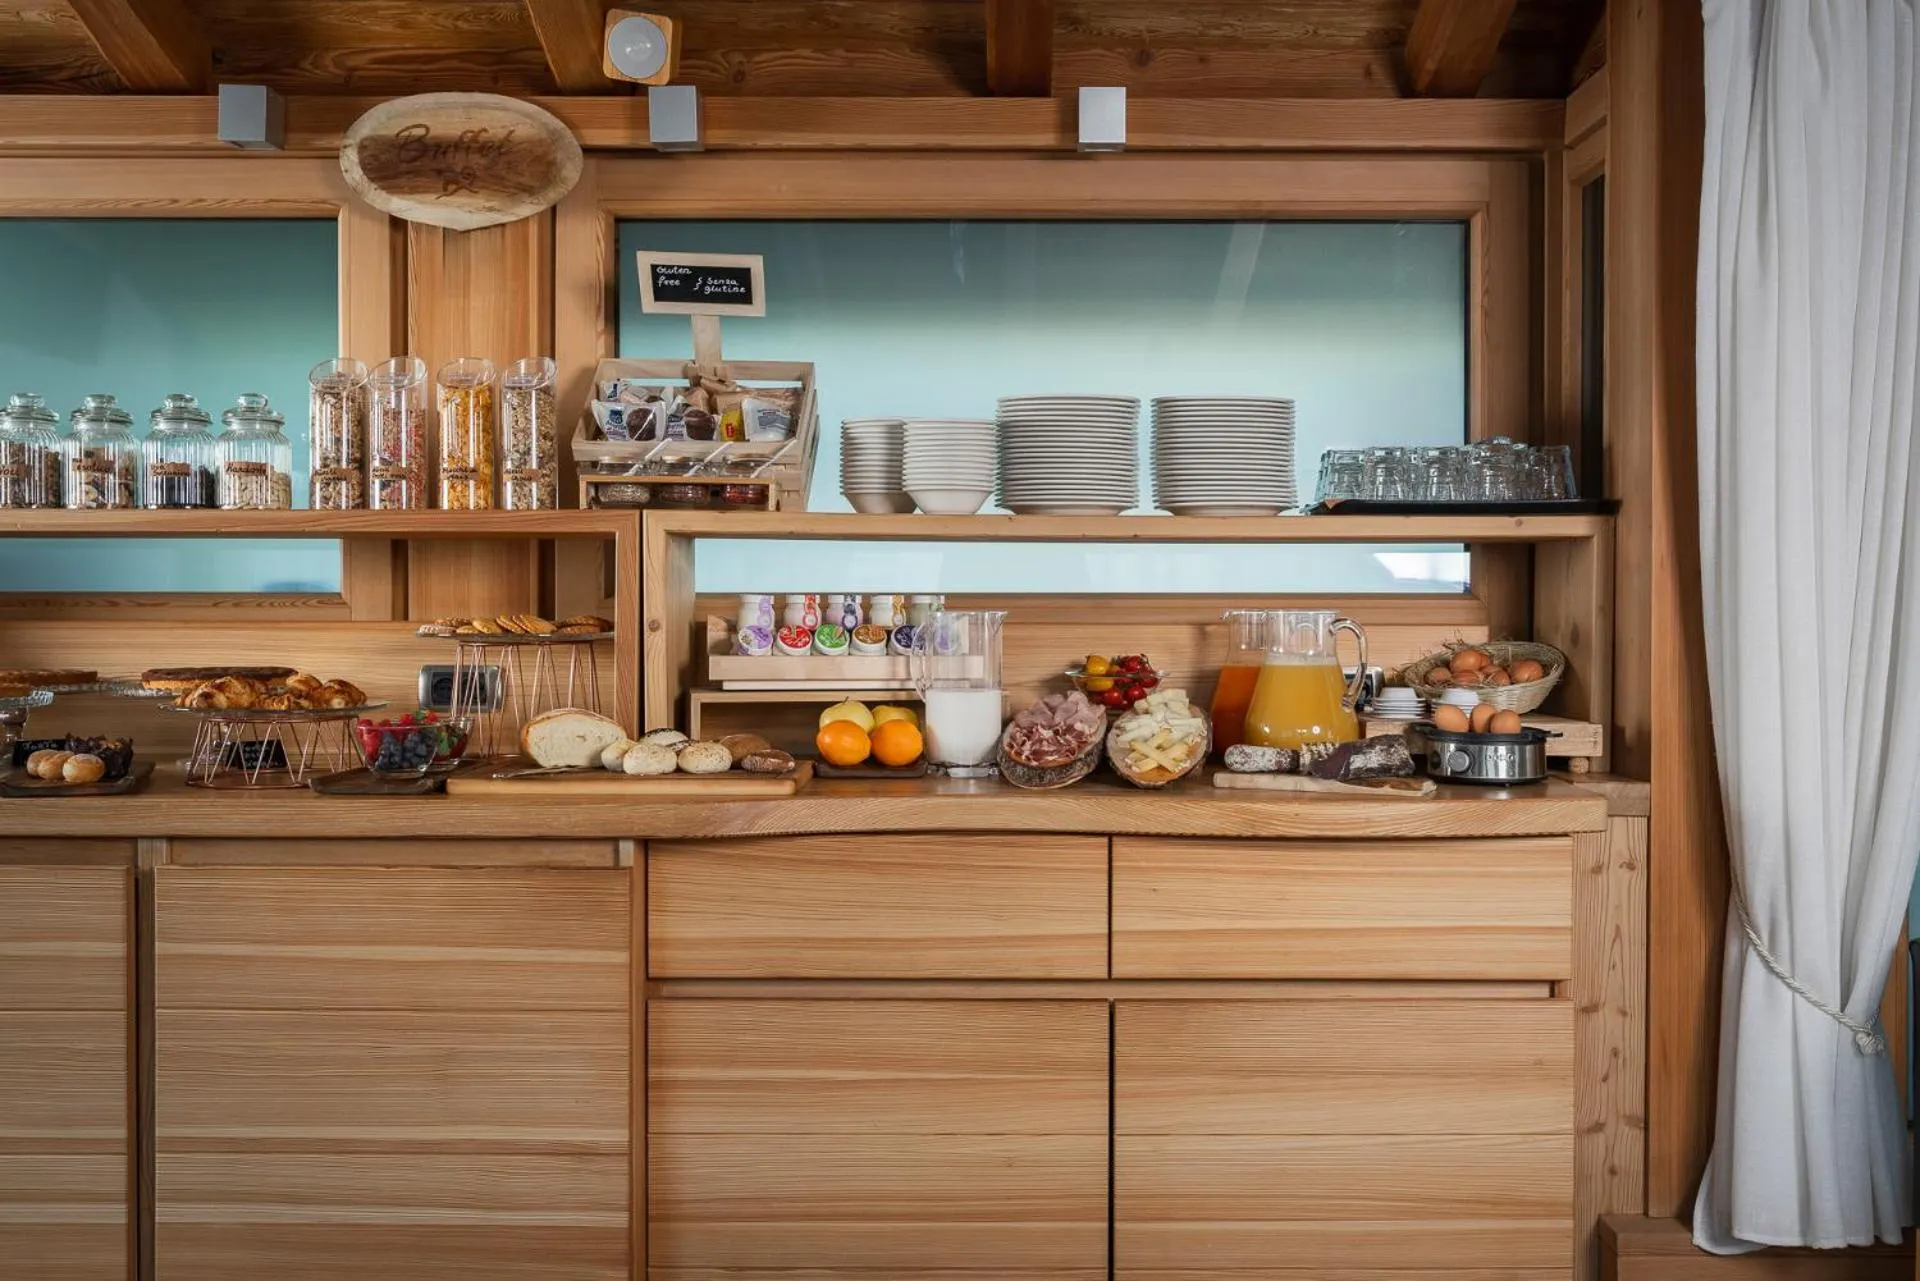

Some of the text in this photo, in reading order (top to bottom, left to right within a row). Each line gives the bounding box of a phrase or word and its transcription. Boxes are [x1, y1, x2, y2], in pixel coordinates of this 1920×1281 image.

[395, 123, 515, 164] Buffet
[658, 275, 680, 287] free
[704, 285, 746, 295] glutine
